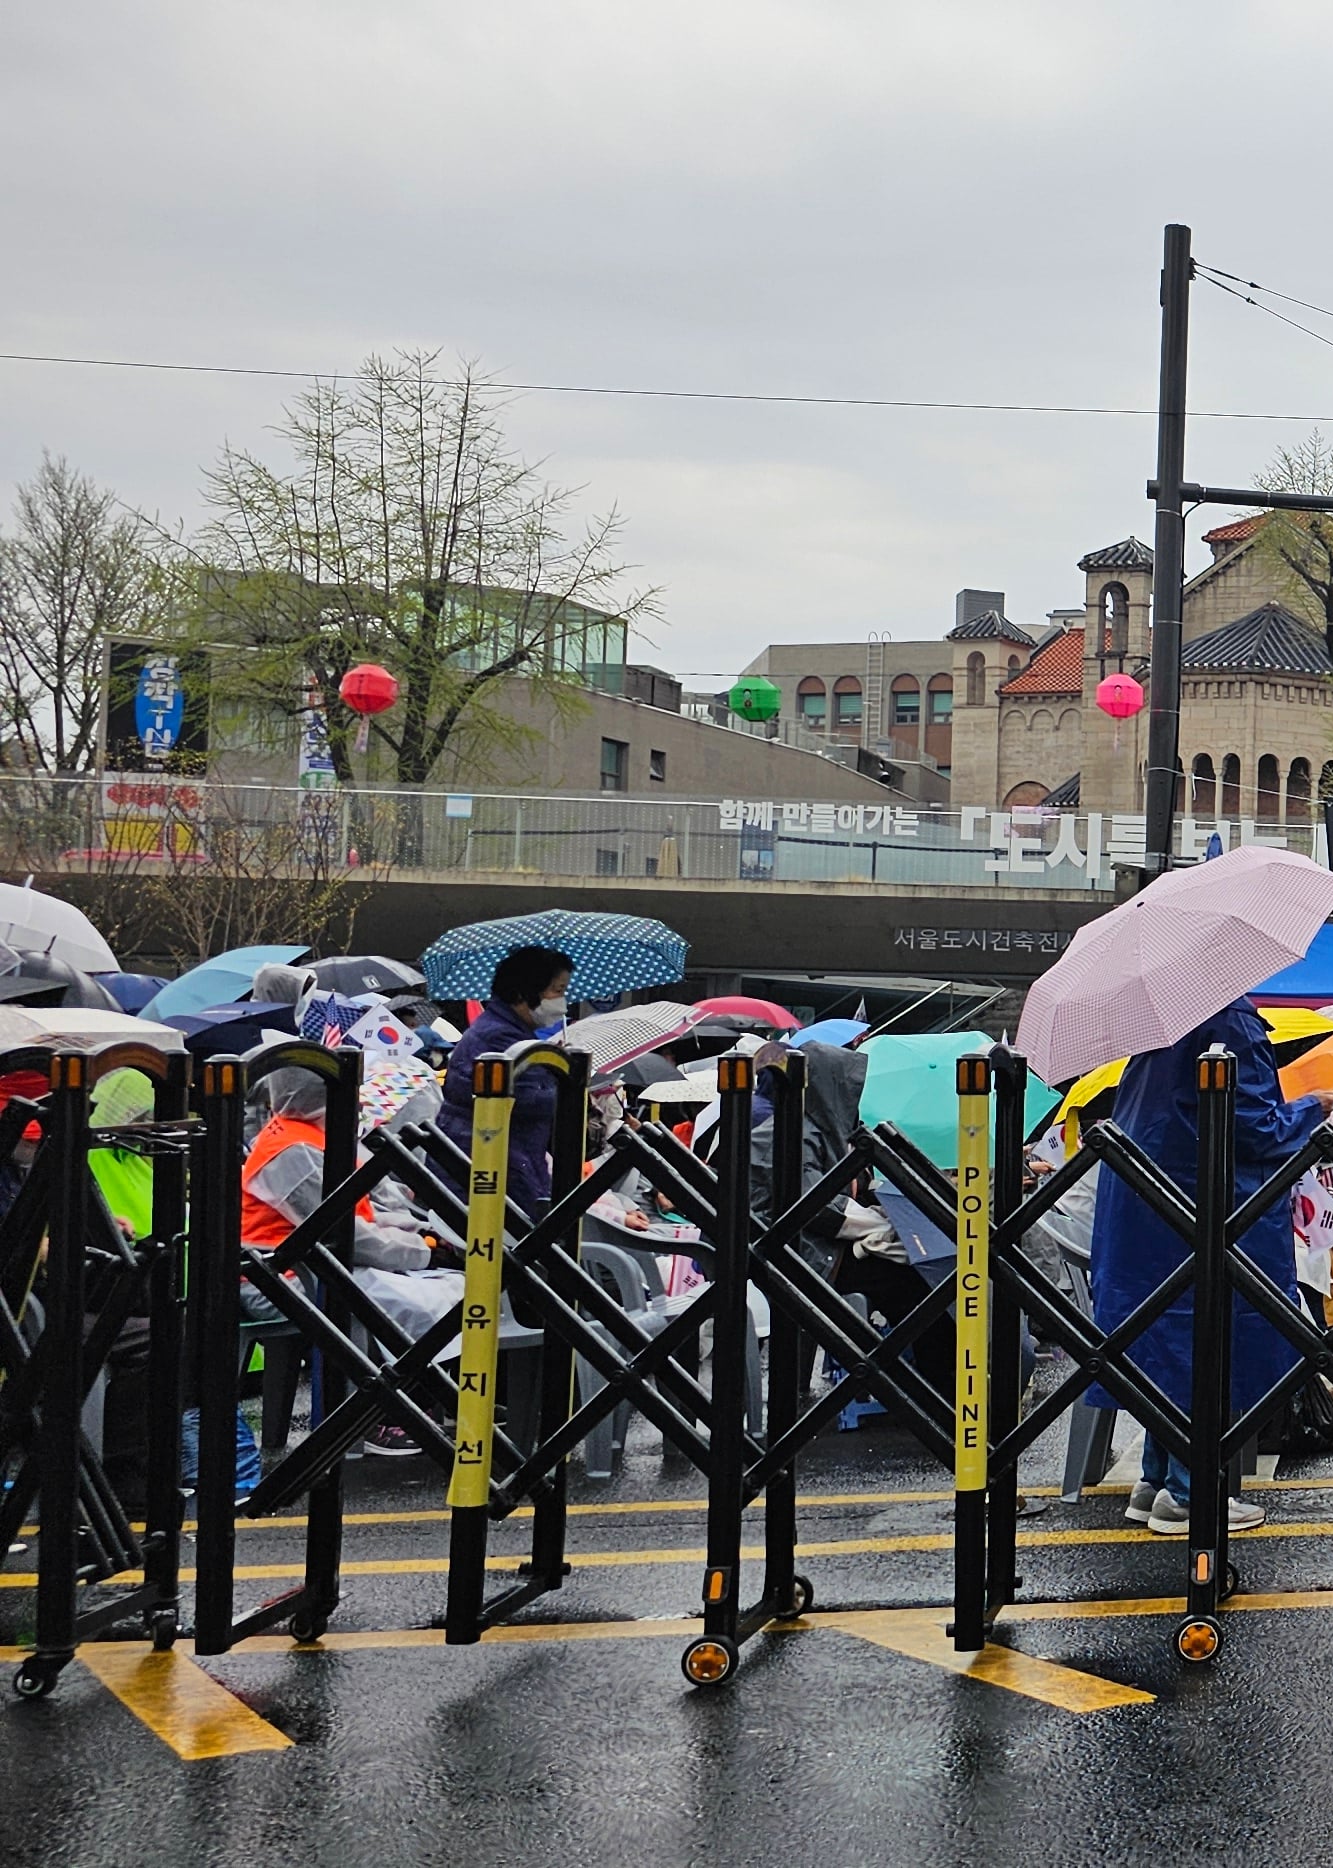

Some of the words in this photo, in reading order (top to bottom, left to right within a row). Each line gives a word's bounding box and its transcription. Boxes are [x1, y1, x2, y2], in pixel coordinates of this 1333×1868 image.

[719, 799, 773, 831] 함께
[782, 802, 920, 836] 만들어가는
[963, 1166, 981, 1318] POLICE
[456, 1168, 498, 1465] 질서유지선
[963, 1349, 978, 1449] LINE
